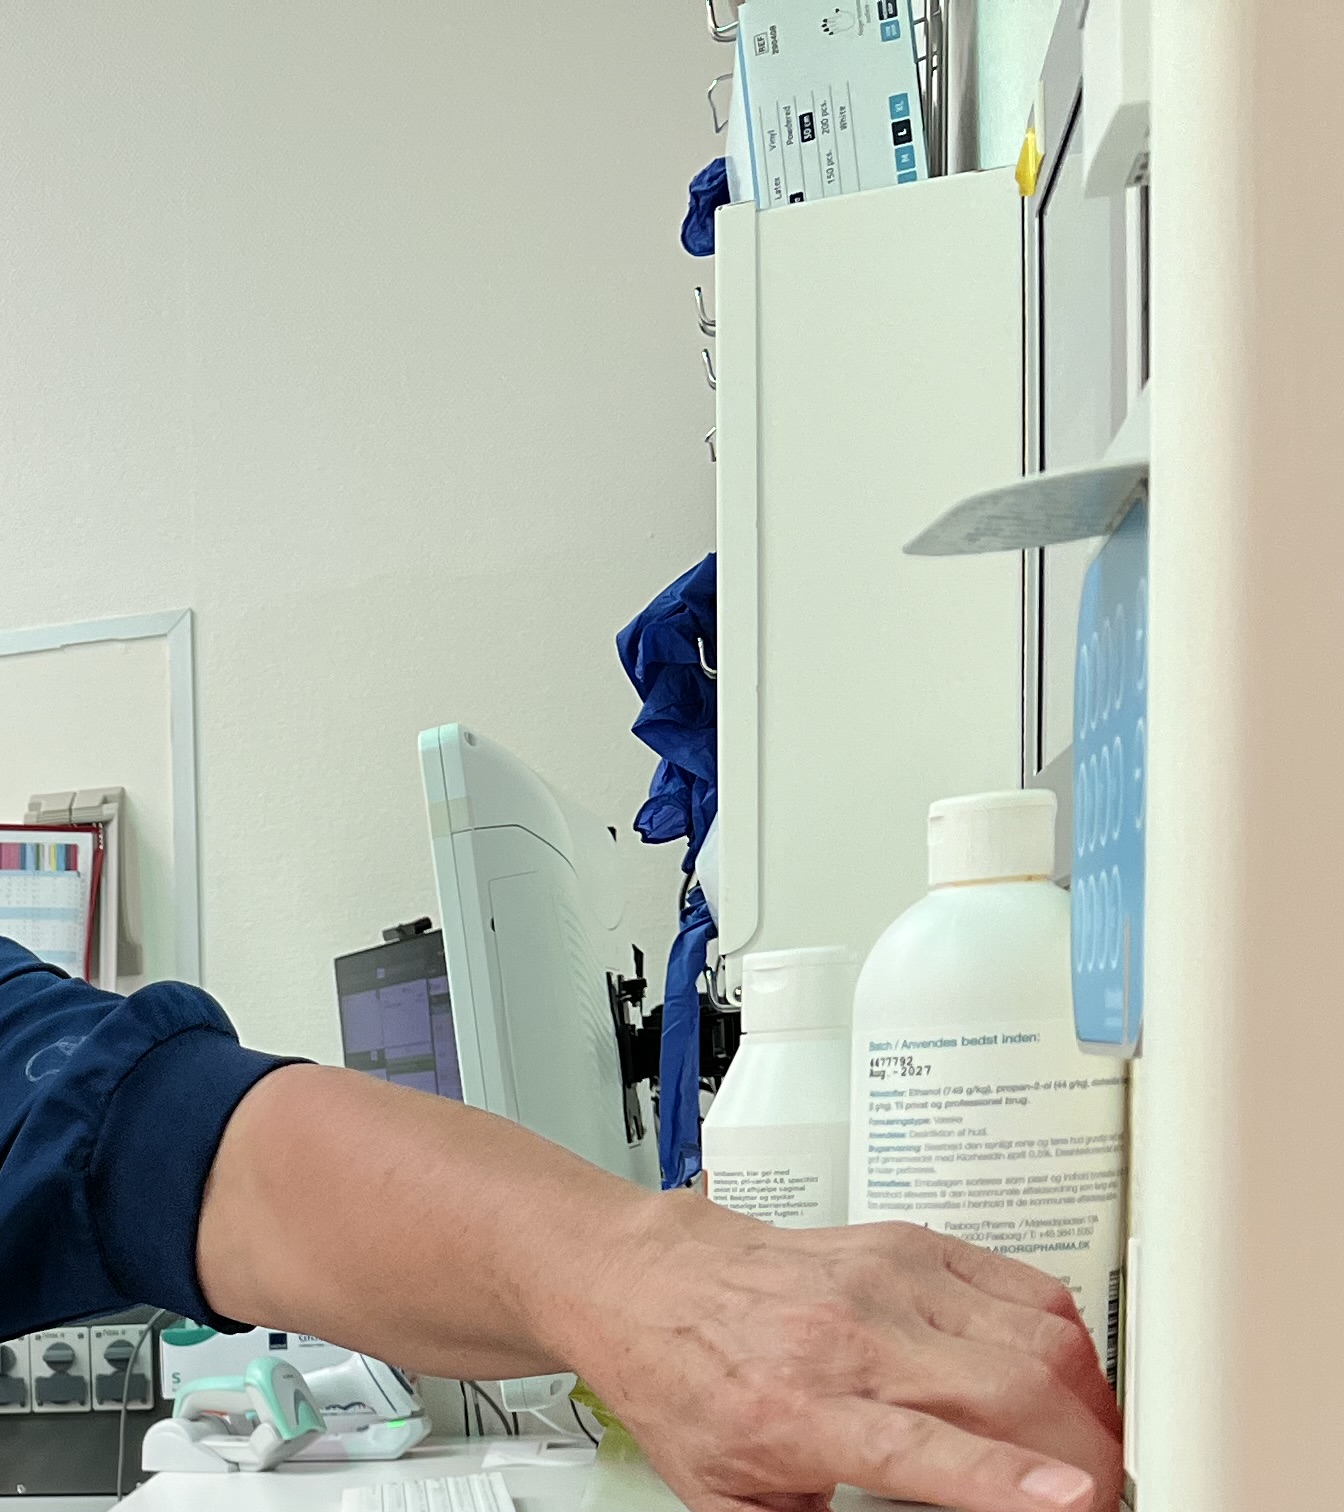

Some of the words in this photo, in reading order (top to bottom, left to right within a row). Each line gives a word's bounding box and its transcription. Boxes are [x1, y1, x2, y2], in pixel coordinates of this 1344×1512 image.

[757, 36, 766, 54] REF
[782, 105, 793, 146] Powdered
[839, 105, 848, 131] White
[820, 119, 831, 135] 200
[769, 129, 778, 151] Vinyl
[825, 167, 835, 184] 150
[901, 1037, 958, 1050] Anvendes
[961, 1034, 999, 1047] bedst
[1002, 1033, 1041, 1045] inden:
[171, 1372, 181, 1385] S
